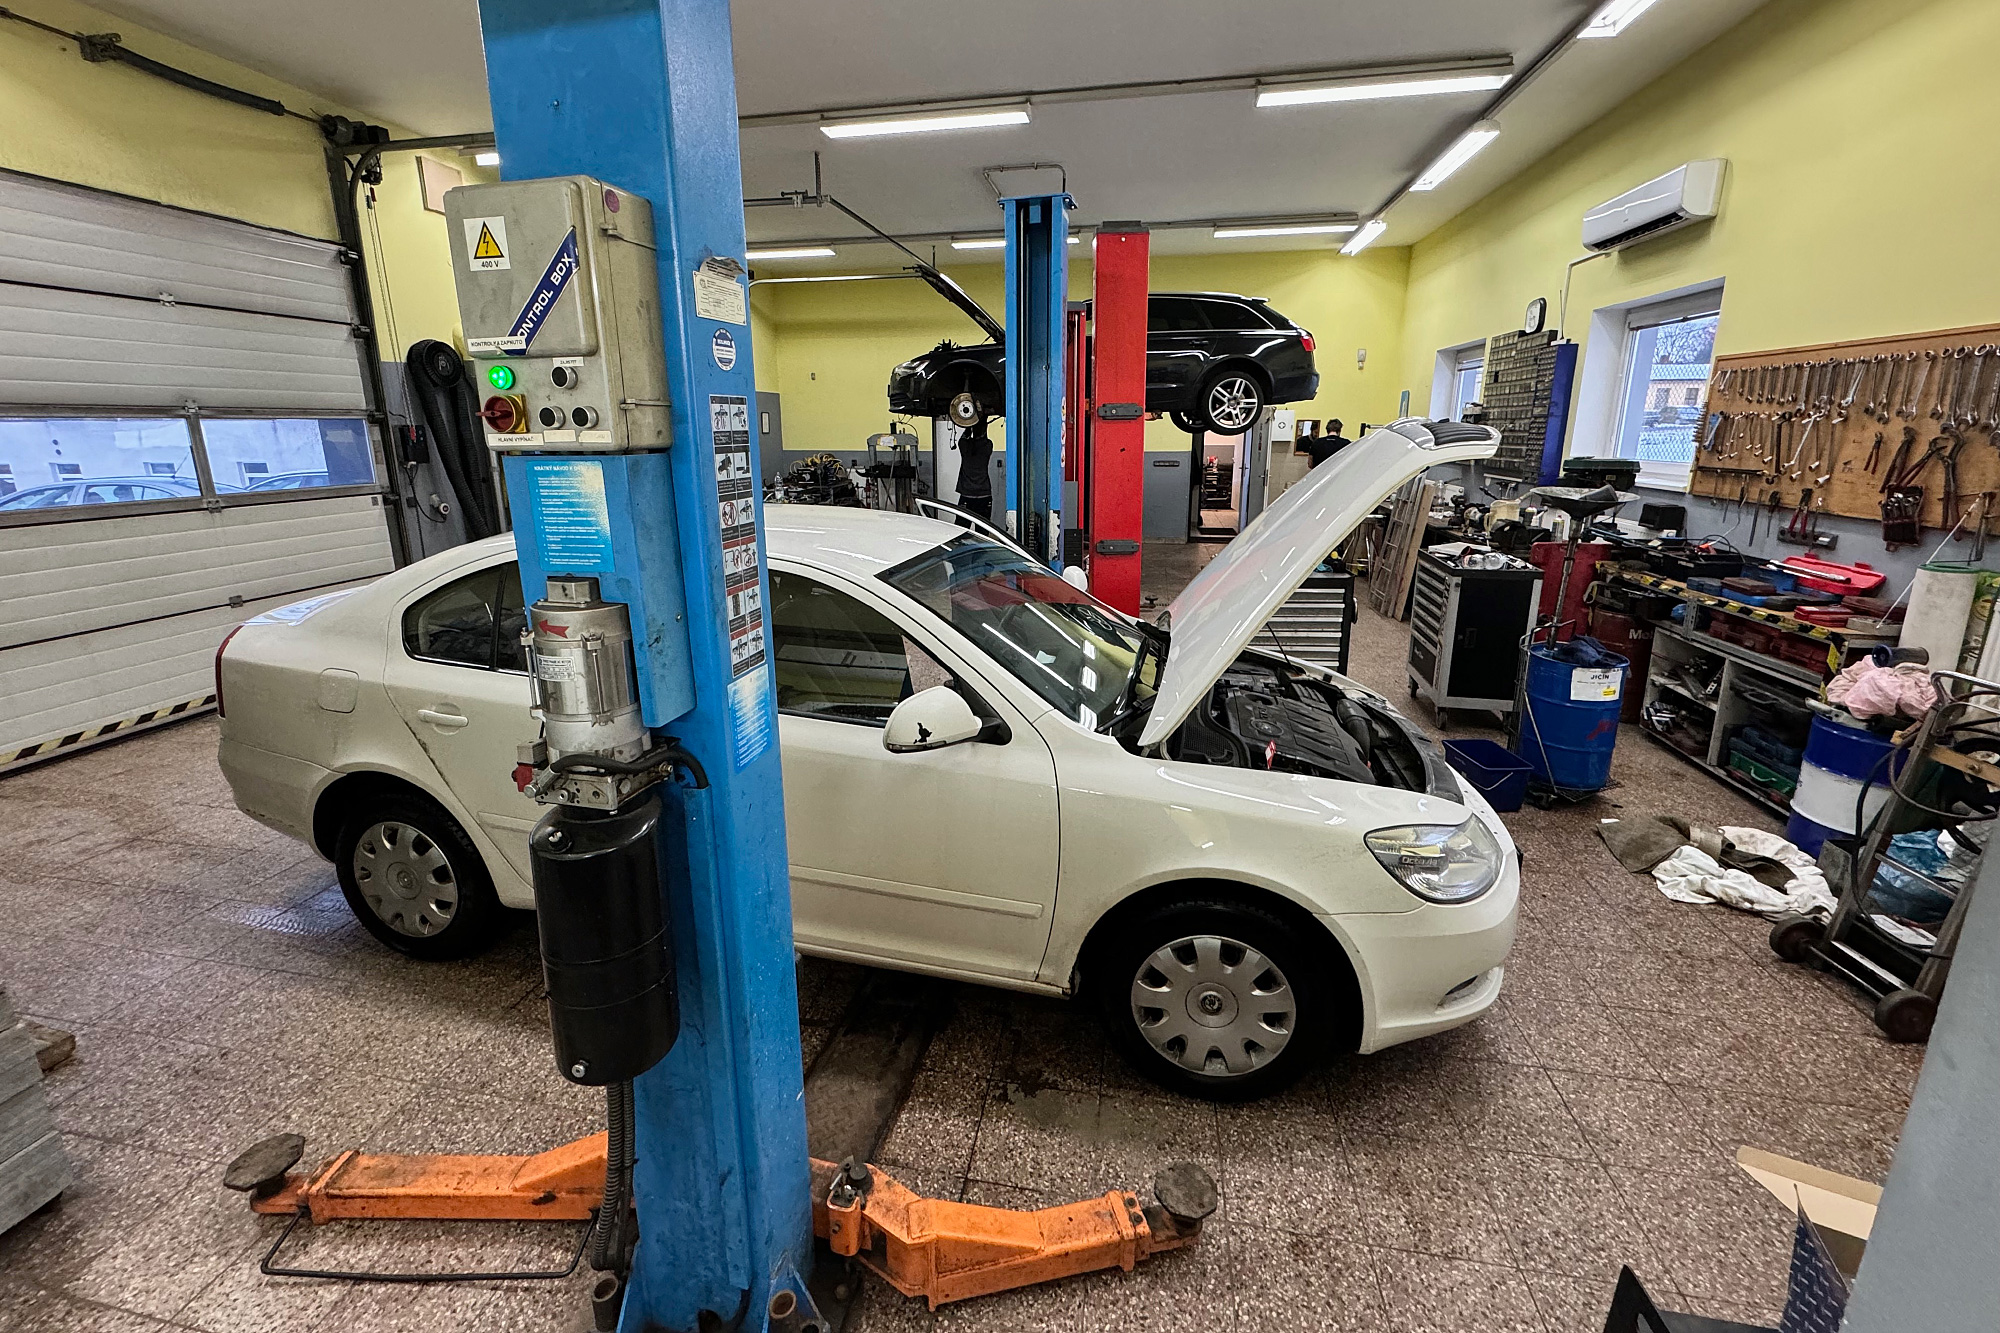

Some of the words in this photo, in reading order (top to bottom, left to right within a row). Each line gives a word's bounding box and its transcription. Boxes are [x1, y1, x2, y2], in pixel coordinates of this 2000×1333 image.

[481, 260, 493, 268] 400
[516, 289, 554, 339] ONTROL
[550, 252, 573, 286] BOX
